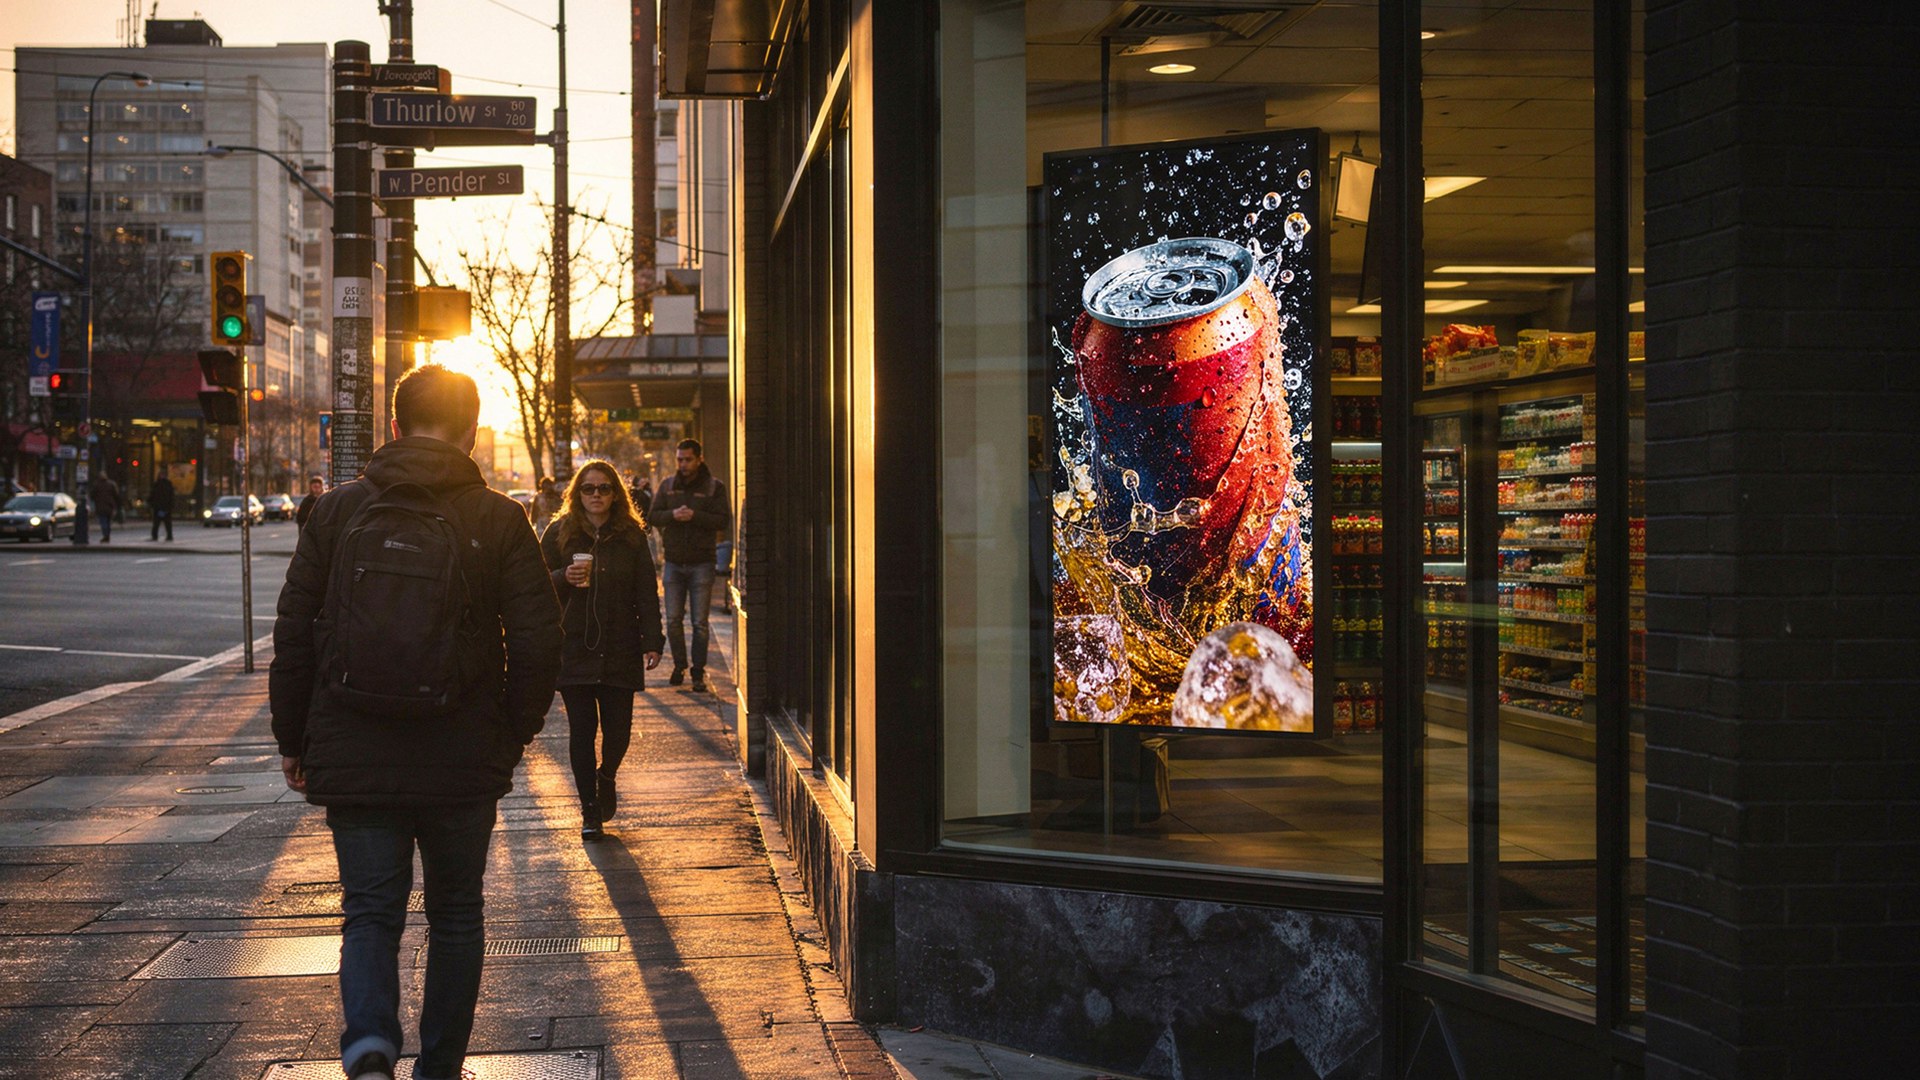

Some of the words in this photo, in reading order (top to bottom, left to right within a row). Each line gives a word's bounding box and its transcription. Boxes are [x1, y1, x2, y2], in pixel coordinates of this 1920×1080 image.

[383, 98, 476, 123] Thurlow
[484, 106, 496, 117] St
[505, 113, 527, 126] 780
[411, 171, 486, 193] Pender
